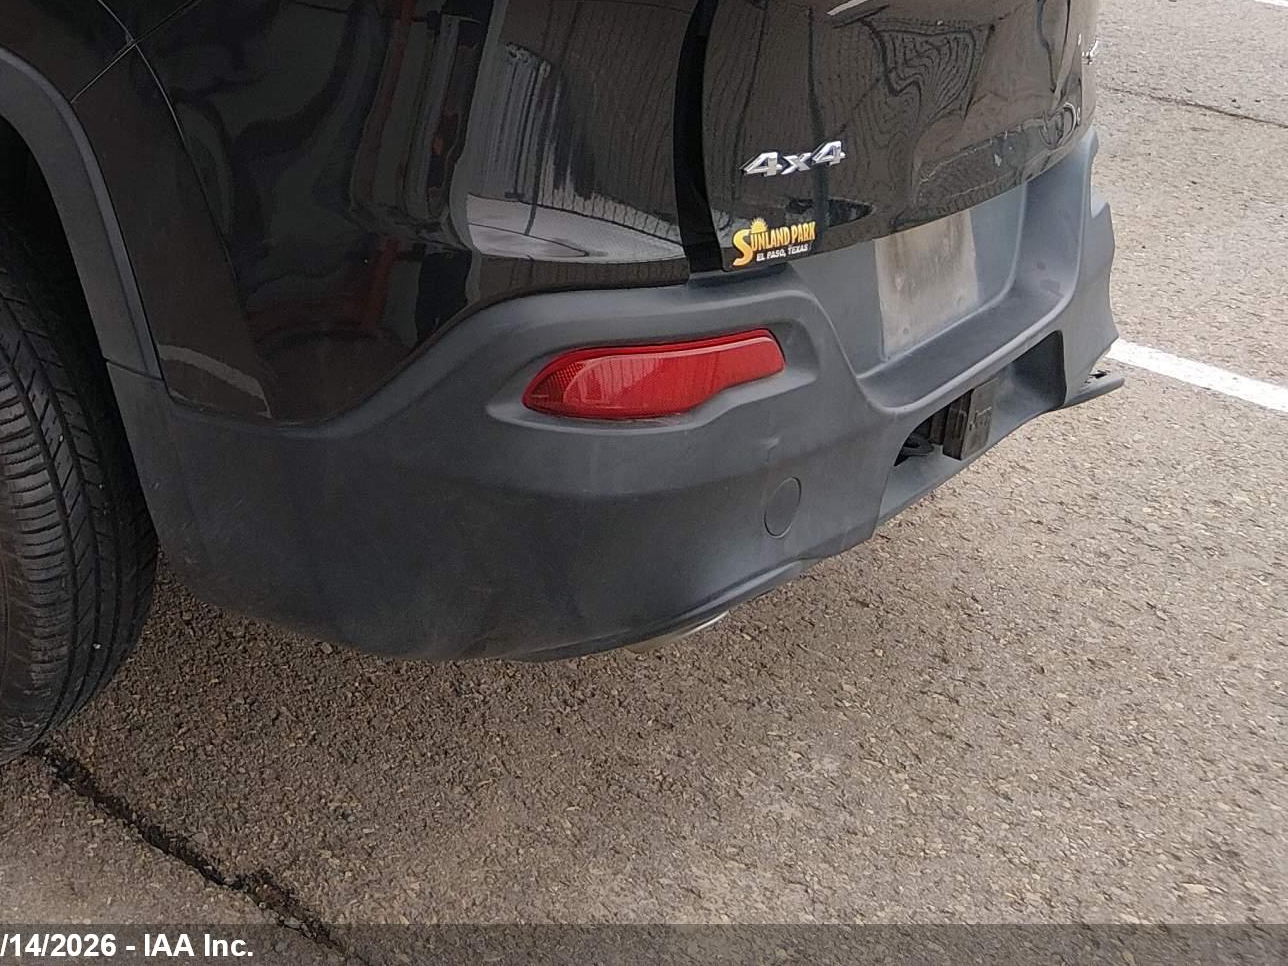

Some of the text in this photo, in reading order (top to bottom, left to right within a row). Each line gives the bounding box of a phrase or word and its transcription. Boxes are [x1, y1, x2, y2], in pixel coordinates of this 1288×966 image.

[742, 140, 846, 177] 4x4
[733, 221, 816, 266] SUNLAND PARK
[756, 243, 809, 262] EL PASO, TEXAS
